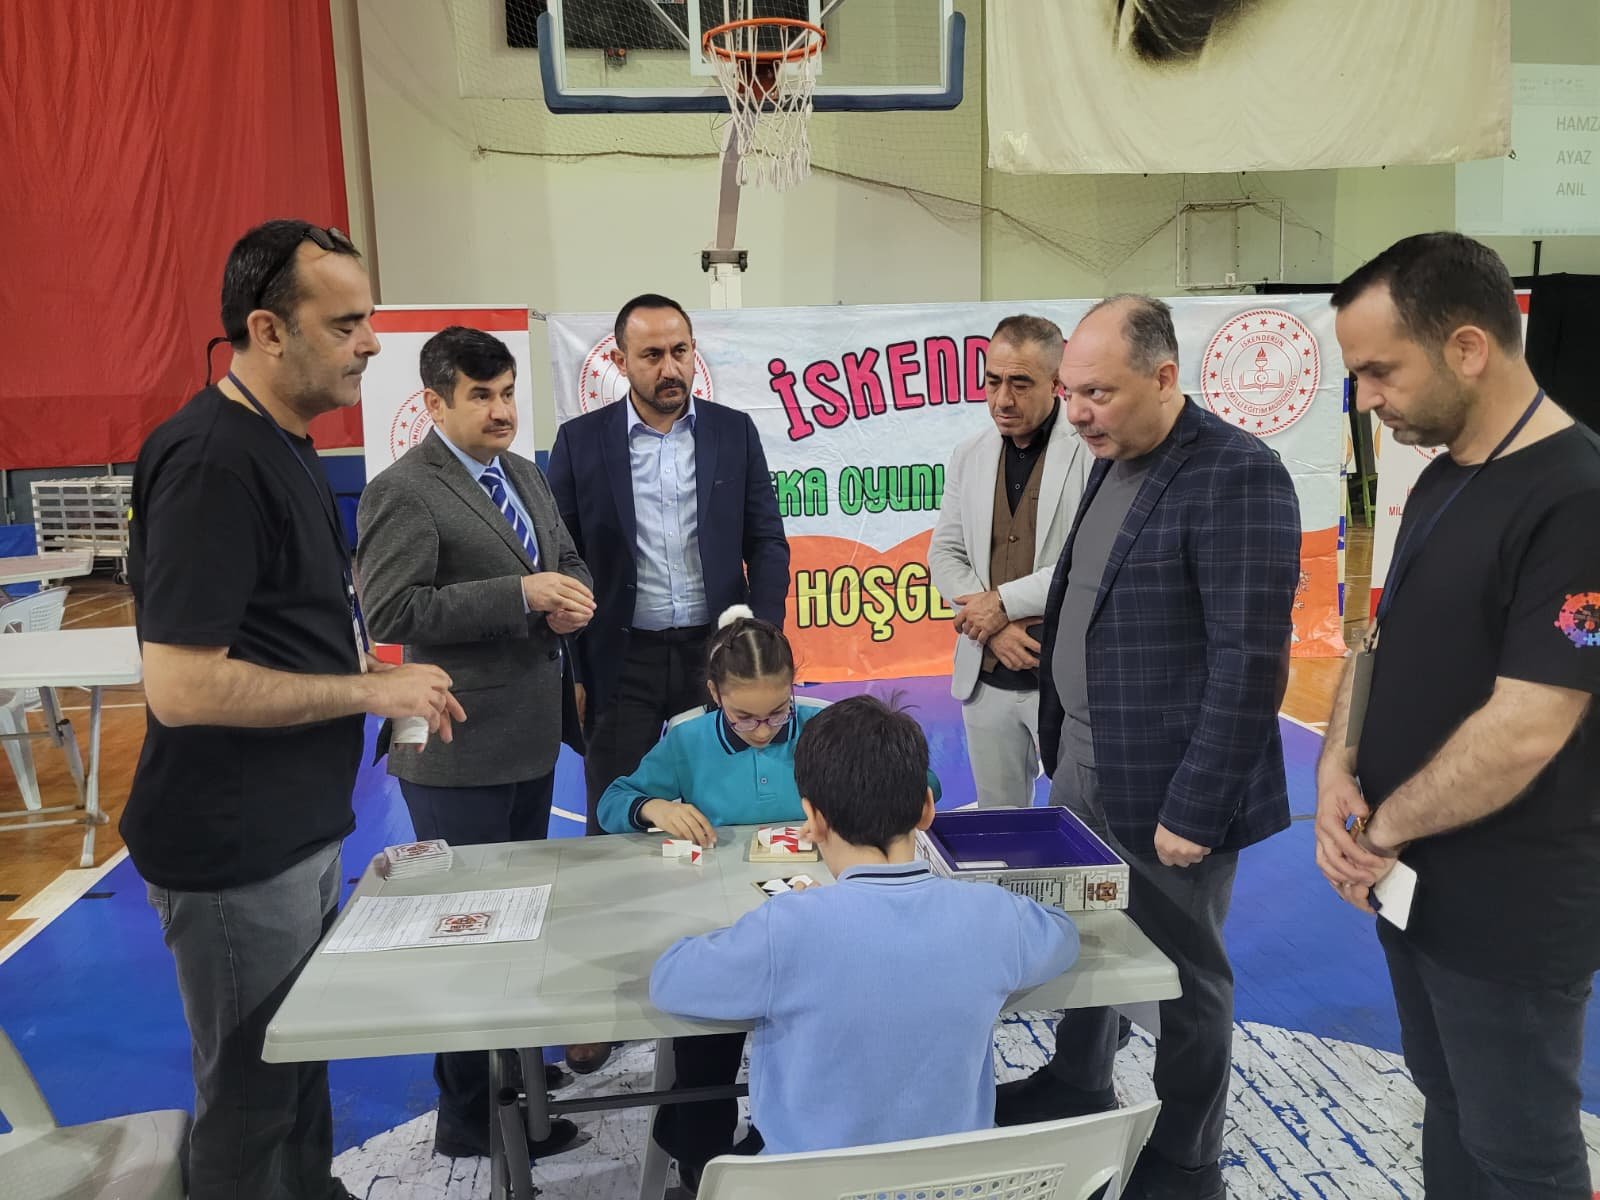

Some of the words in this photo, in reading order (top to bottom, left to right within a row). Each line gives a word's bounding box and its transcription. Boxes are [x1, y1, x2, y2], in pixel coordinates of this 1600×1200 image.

[1556, 115, 1600, 132] HAMZ
[1556, 149, 1592, 165] AYAZ
[1239, 334, 1284, 348] İSKENDERUN
